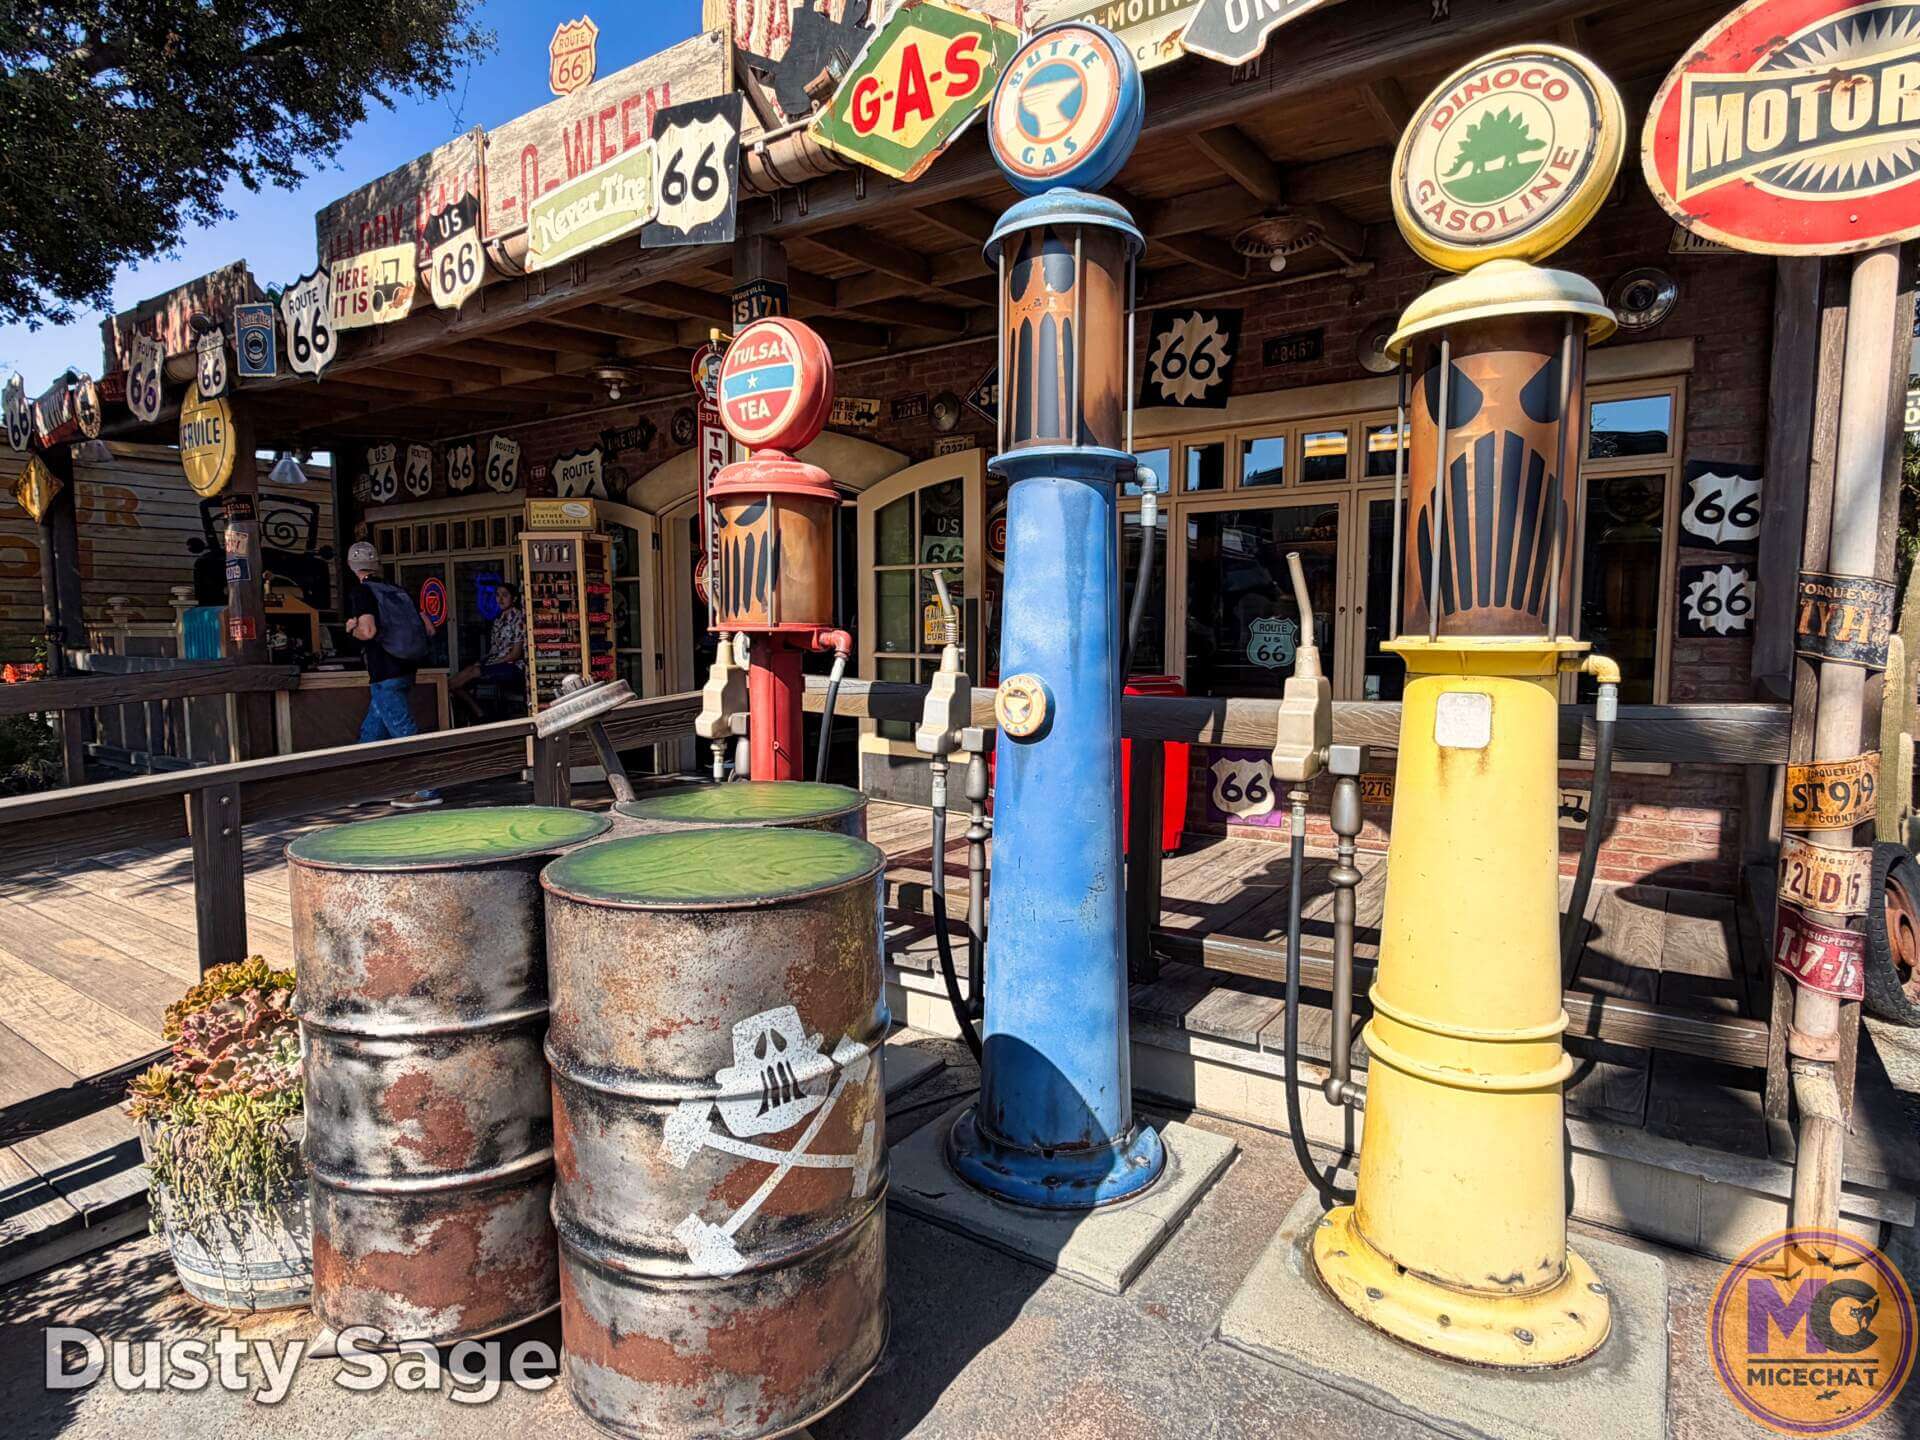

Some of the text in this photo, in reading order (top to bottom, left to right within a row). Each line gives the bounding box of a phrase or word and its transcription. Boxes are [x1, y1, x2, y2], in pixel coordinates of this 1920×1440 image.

[559, 31, 585, 49] ROUTE
[558, 54, 584, 84] 66
[851, 35, 981, 135] G-A-S
[1430, 68, 1570, 131] DINOCO
[1690, 60, 1920, 176] MOTOR
[1021, 136, 1078, 166] GAS
[661, 140, 720, 206] 66
[1417, 145, 1580, 234] GASOLINE
[438, 208, 463, 239] US
[537, 171, 647, 247] Never Tire
[335, 265, 369, 293] HERE
[440, 242, 475, 295] 66
[289, 286, 319, 316] ROUTE
[334, 291, 369, 319] IT IS
[293, 306, 330, 364] 66
[733, 340, 781, 368] TULSA
[1161, 335, 1216, 380] 66
[131, 363, 157, 413] 66
[203, 359, 222, 390] 66
[738, 398, 771, 422] TEA
[375, 448, 388, 462] US
[495, 440, 515, 455] ROUTE
[369, 465, 394, 496] 66
[406, 462, 430, 492] 66
[451, 456, 472, 480] 66
[488, 454, 514, 488] 66
[562, 461, 596, 481] ROUTE
[1694, 489, 1760, 527] 66
[937, 518, 960, 534] US
[1697, 582, 1752, 616] 66
[1258, 623, 1288, 633] ROUTE
[1257, 644, 1286, 662] 66
[1221, 772, 1268, 803] 66
